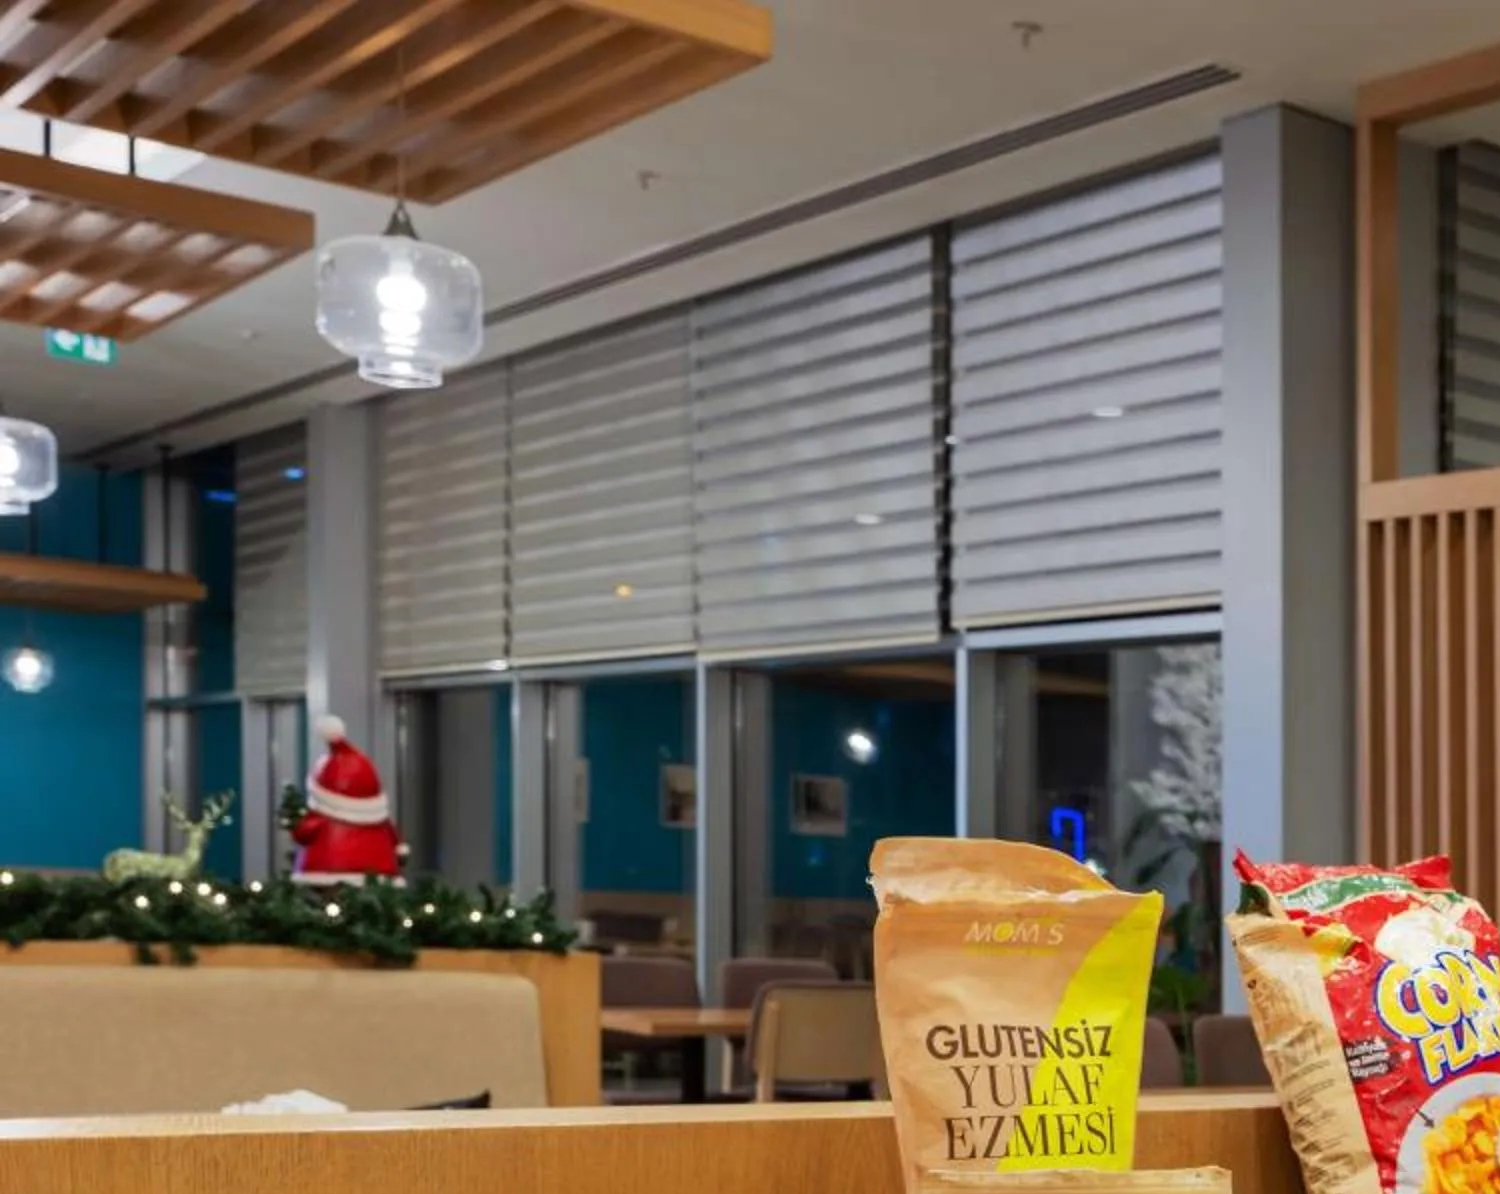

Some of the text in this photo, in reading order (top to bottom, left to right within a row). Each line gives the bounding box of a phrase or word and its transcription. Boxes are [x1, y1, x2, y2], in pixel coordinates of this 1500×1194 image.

[964, 919, 1066, 946] MOMS
[926, 1019, 1113, 1060] GLUTENSİZ
[951, 1062, 1104, 1110] YULAF
[943, 1106, 1118, 1161] EZMESİ
